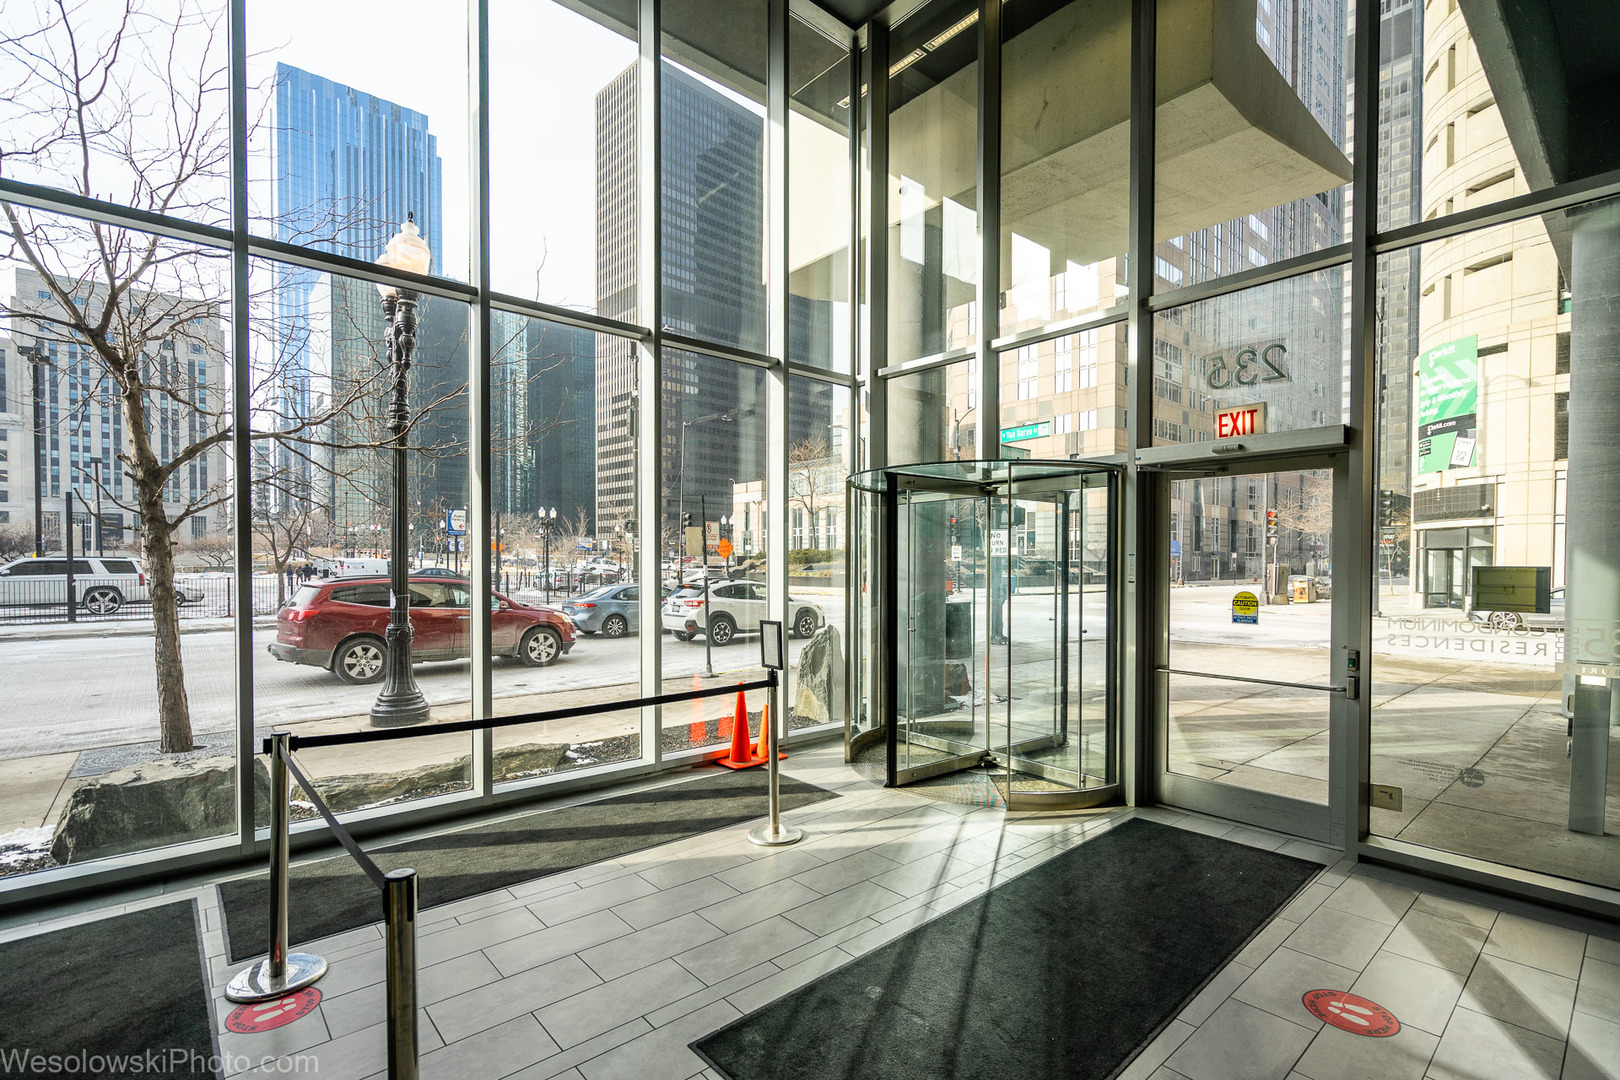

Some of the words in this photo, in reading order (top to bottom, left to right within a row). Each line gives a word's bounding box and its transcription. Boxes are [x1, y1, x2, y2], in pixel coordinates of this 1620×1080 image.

[1218, 409, 1258, 438] EXIT
[1006, 430, 1016, 439] Van
[1017, 428, 1033, 438] Buren
[1312, 991, 1337, 1000] STOP
[295, 998, 315, 1015] STOP
[1308, 999, 1328, 1018] HERE
[1372, 1006, 1394, 1025] STOP
[232, 1022, 258, 1031] STOP
[1363, 1024, 1393, 1035] HERE
